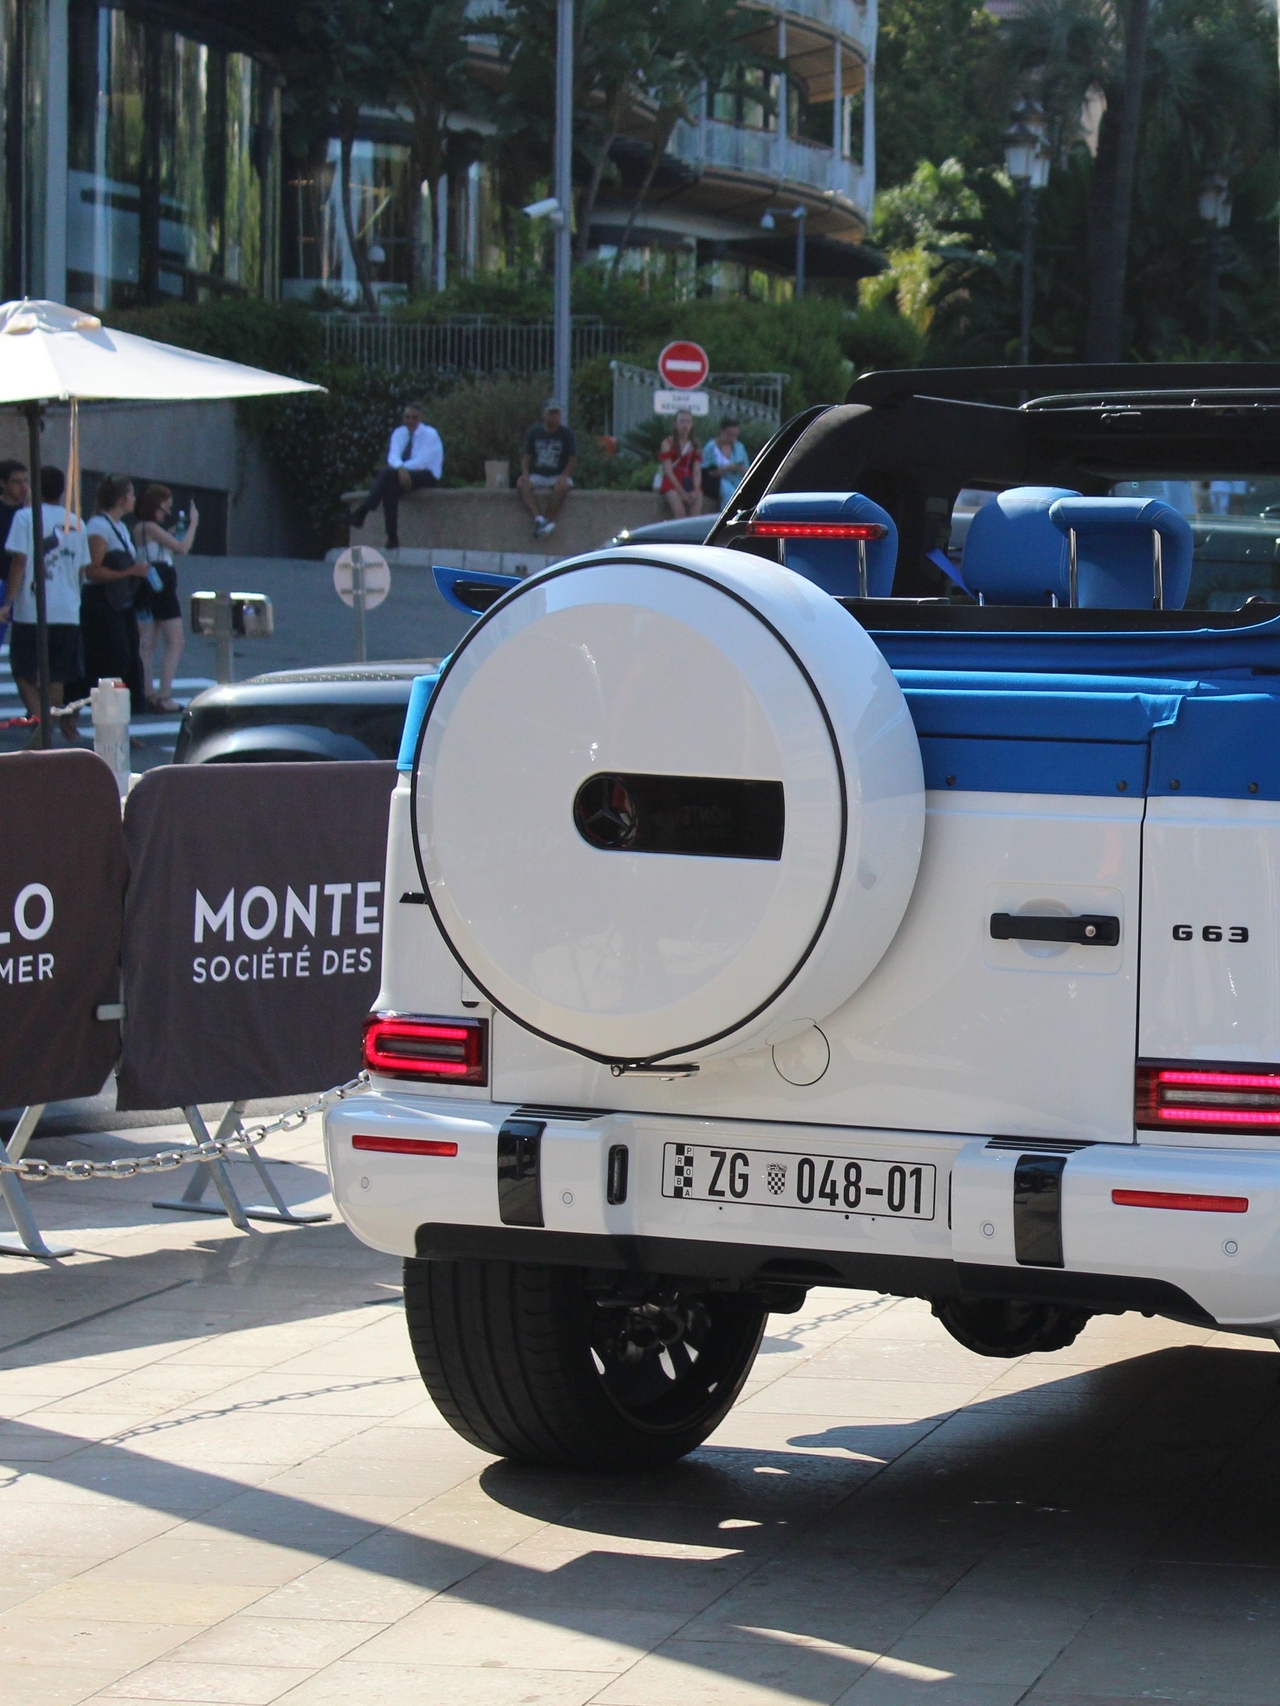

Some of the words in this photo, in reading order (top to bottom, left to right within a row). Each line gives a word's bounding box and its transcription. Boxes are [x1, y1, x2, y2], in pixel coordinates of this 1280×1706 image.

[194, 881, 381, 943] MONTE
[193, 945, 310, 984] SOCIÉTÉ
[322, 947, 372, 976] DES
[708, 1150, 749, 1198] ZG
[796, 1157, 923, 1213] 048-01
